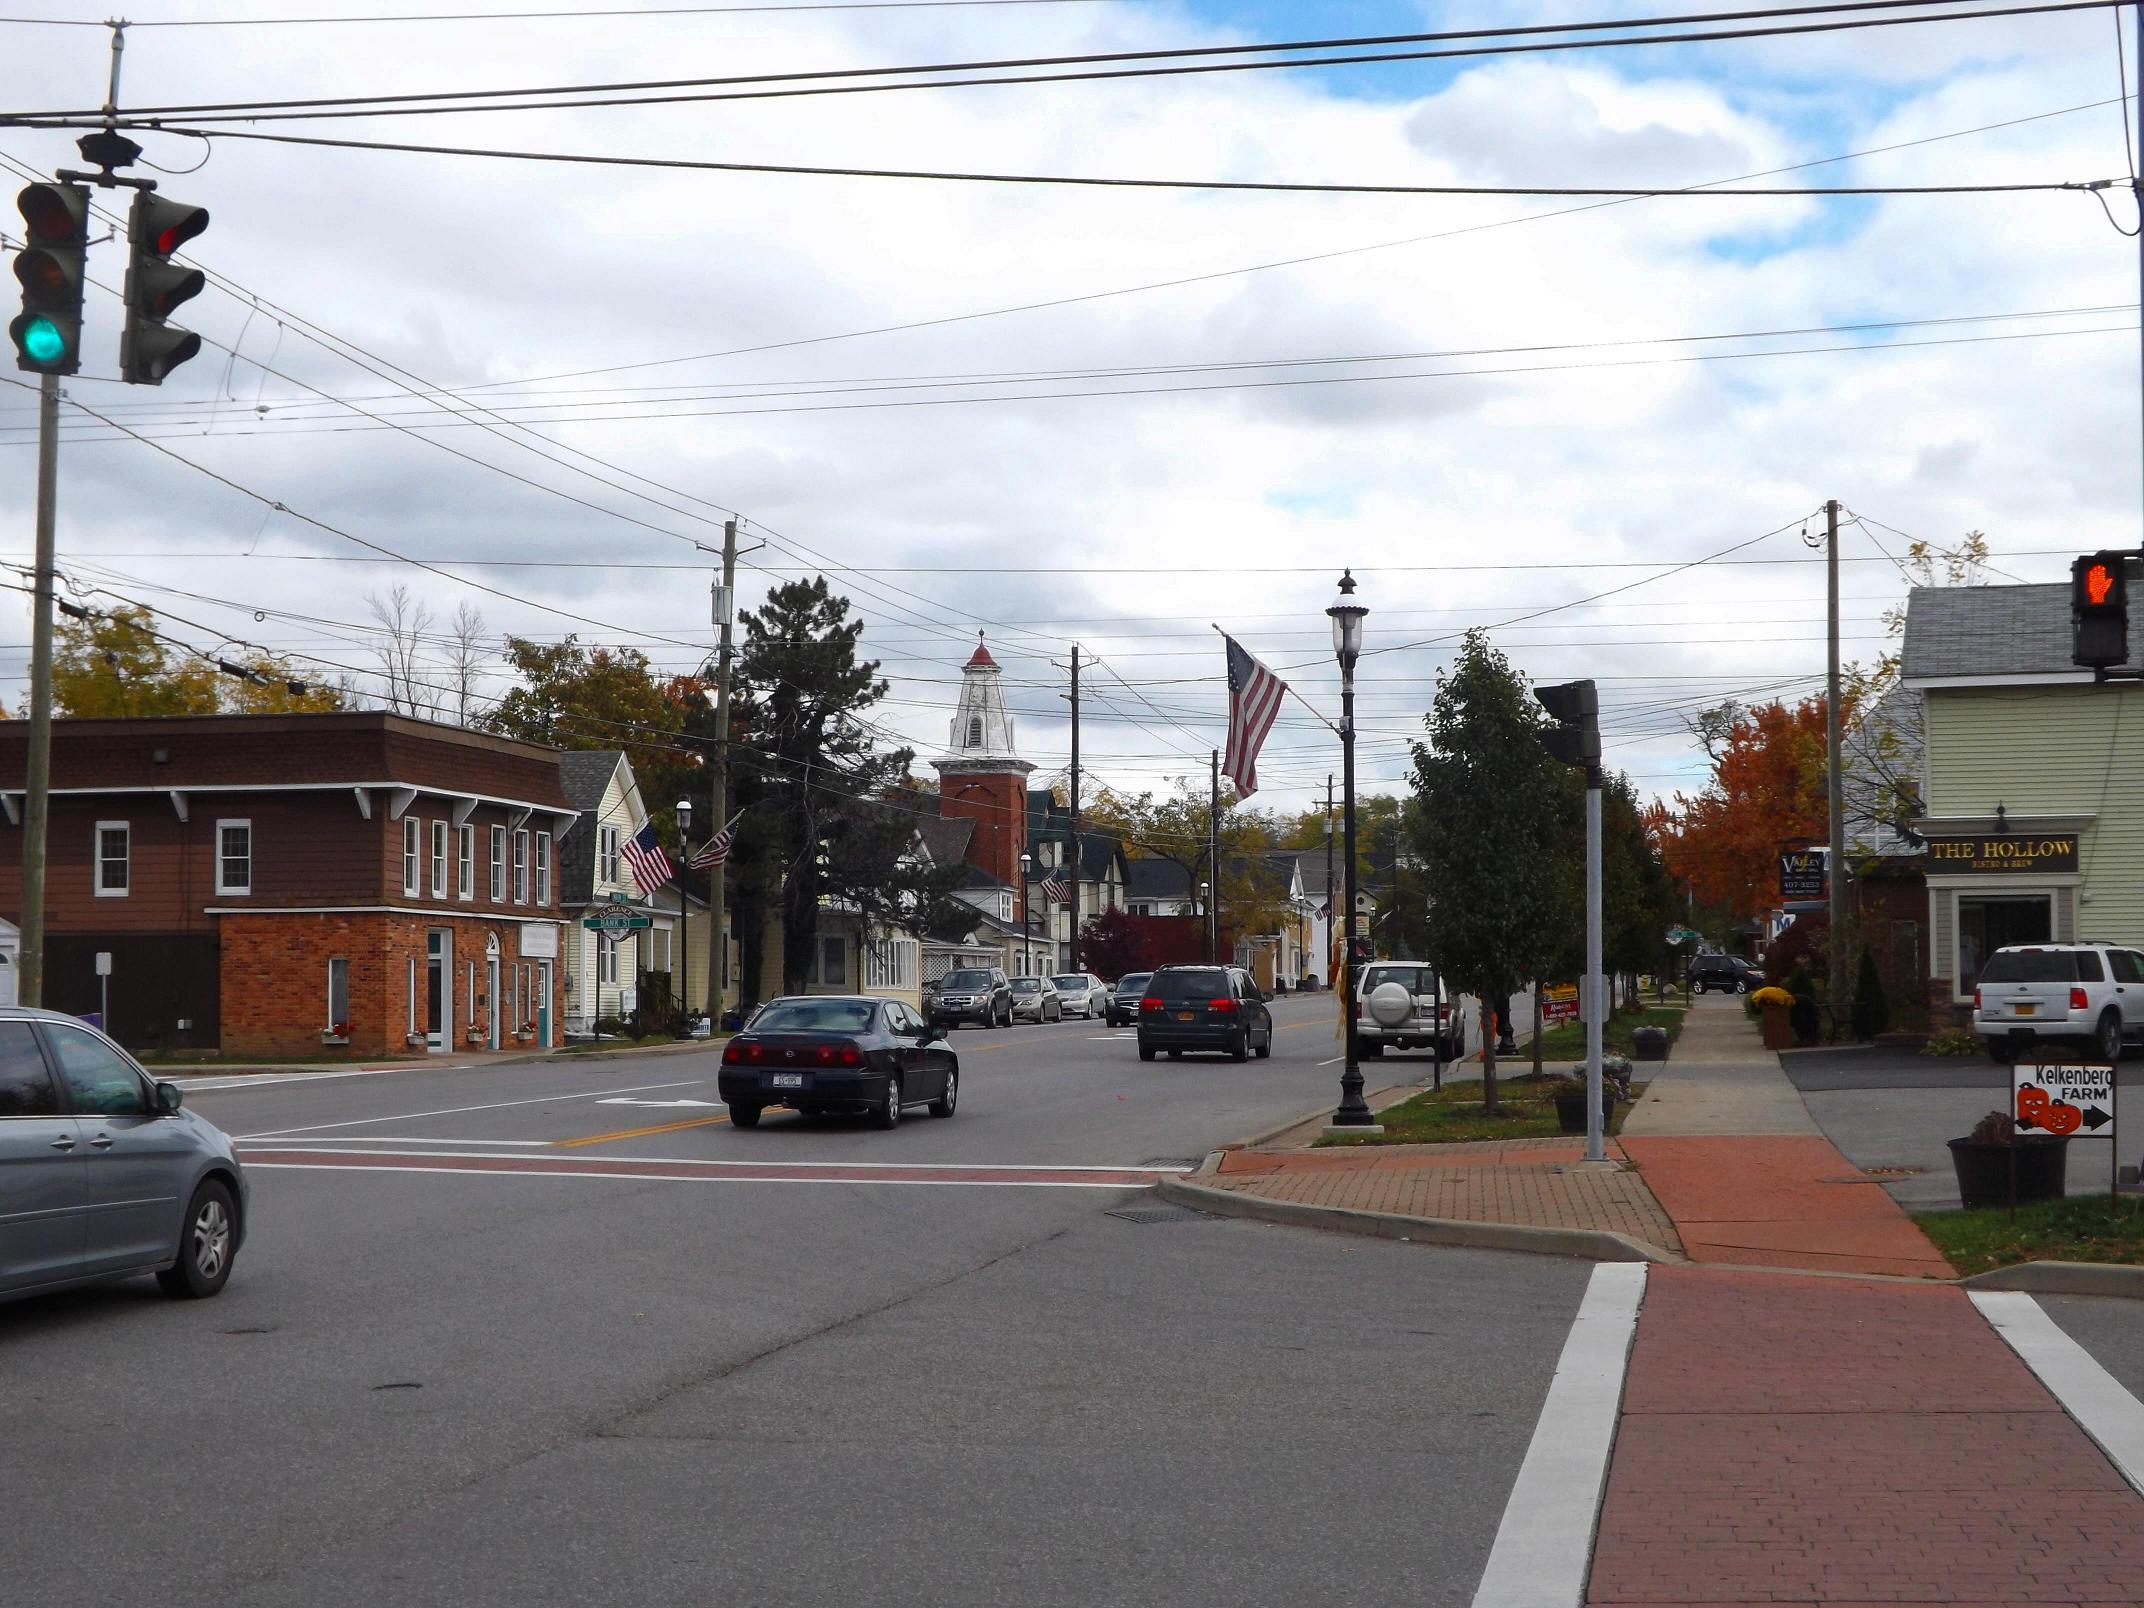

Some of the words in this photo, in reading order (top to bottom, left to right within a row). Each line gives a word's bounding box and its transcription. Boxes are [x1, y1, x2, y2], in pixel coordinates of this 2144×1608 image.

[1931, 843, 1975, 859] THE
[1983, 841, 2074, 858] HOLLOW
[599, 905, 633, 919] CLARENCE
[601, 919, 619, 928] BANK
[622, 919, 630, 928] ST
[2036, 1065, 2113, 1091] Kelkenberg
[2061, 1087, 2108, 1100] FARM
